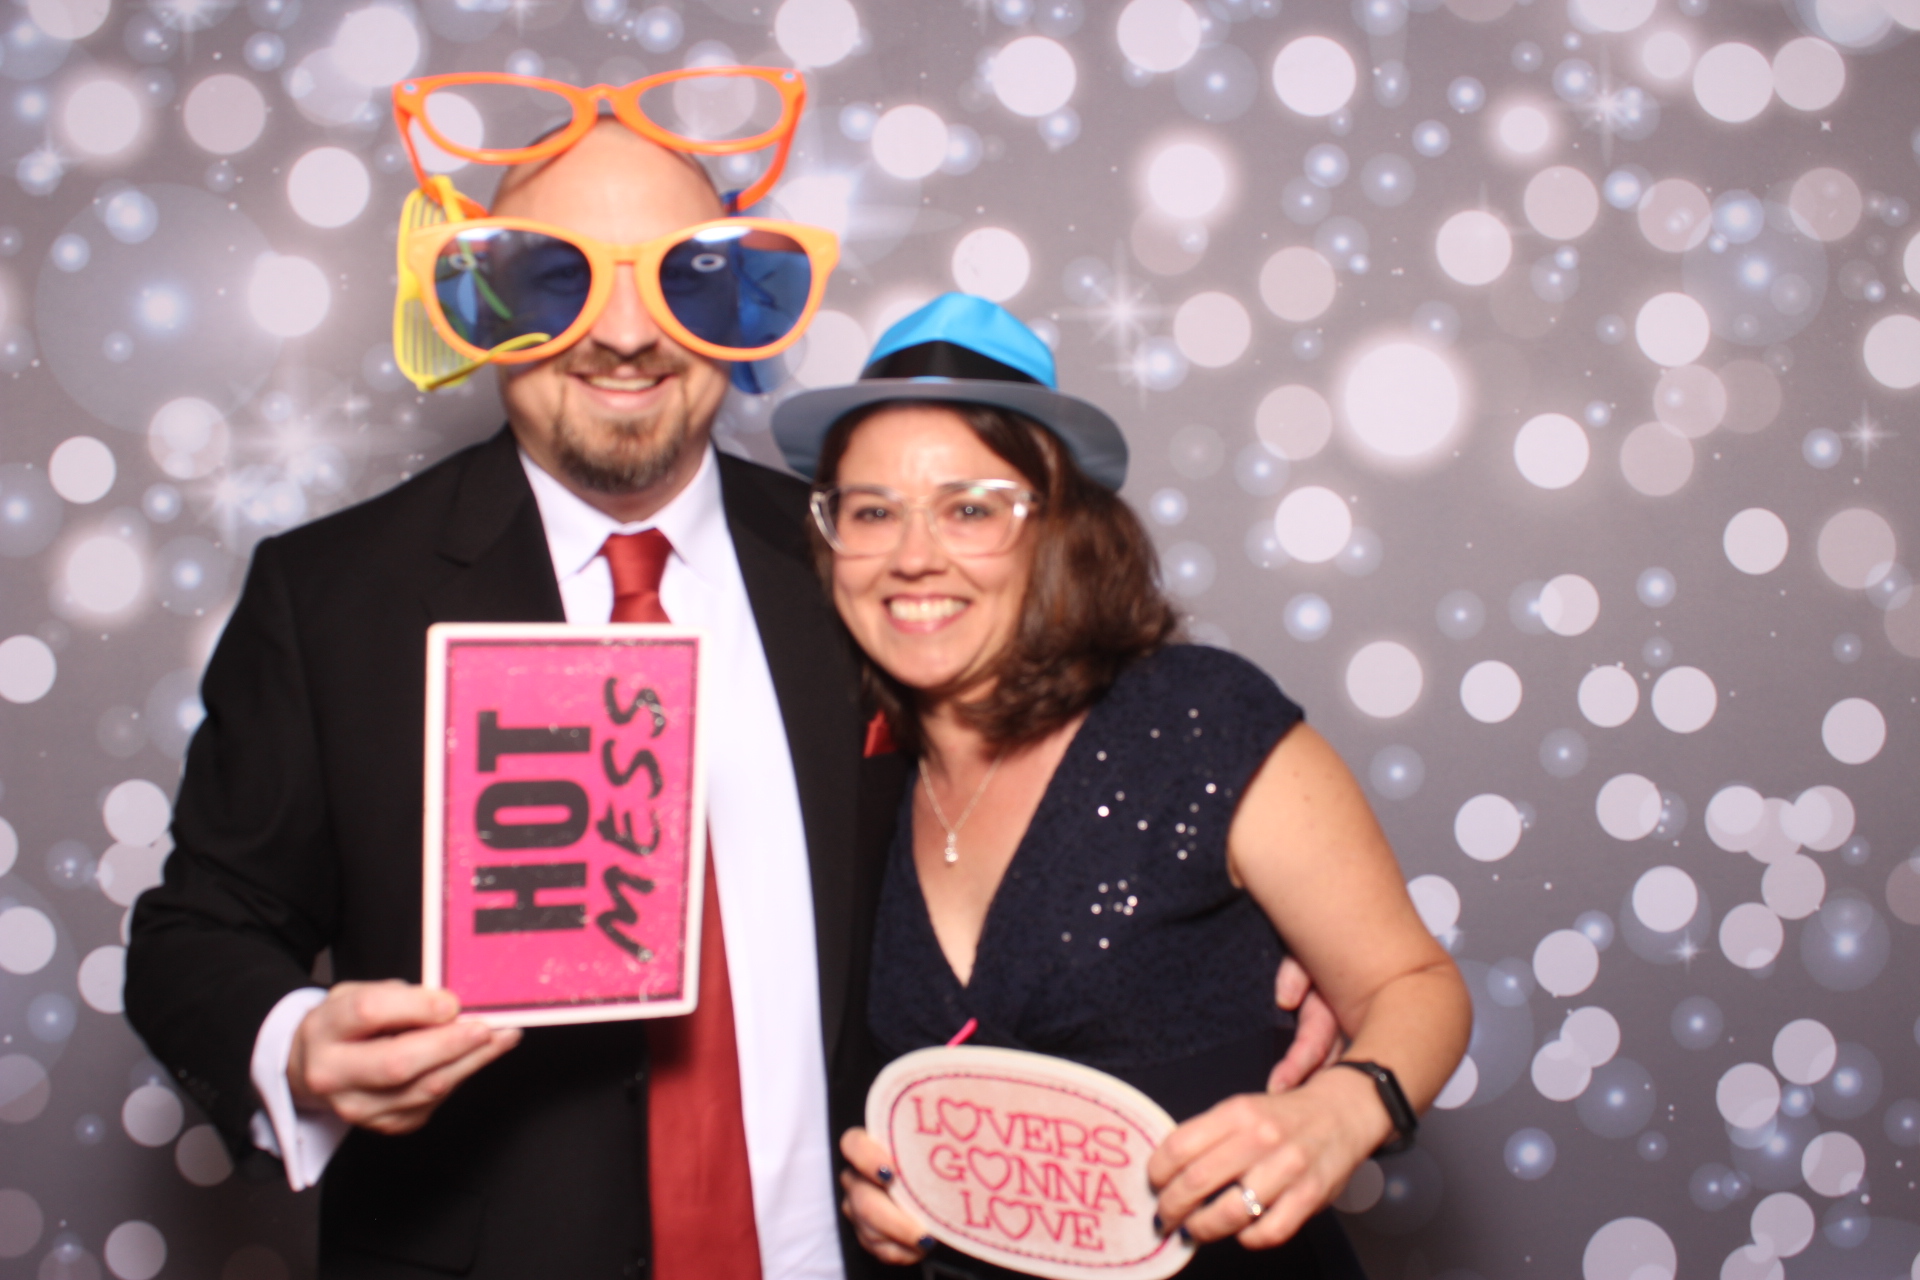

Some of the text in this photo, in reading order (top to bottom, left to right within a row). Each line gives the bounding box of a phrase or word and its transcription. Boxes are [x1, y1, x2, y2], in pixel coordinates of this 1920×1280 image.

[473, 710, 591, 935] HOT
[597, 677, 666, 964] MESS
[911, 1096, 1131, 1169] LOVERS
[928, 1144, 1136, 1217] GONNA
[960, 1190, 1104, 1251] LOVE
